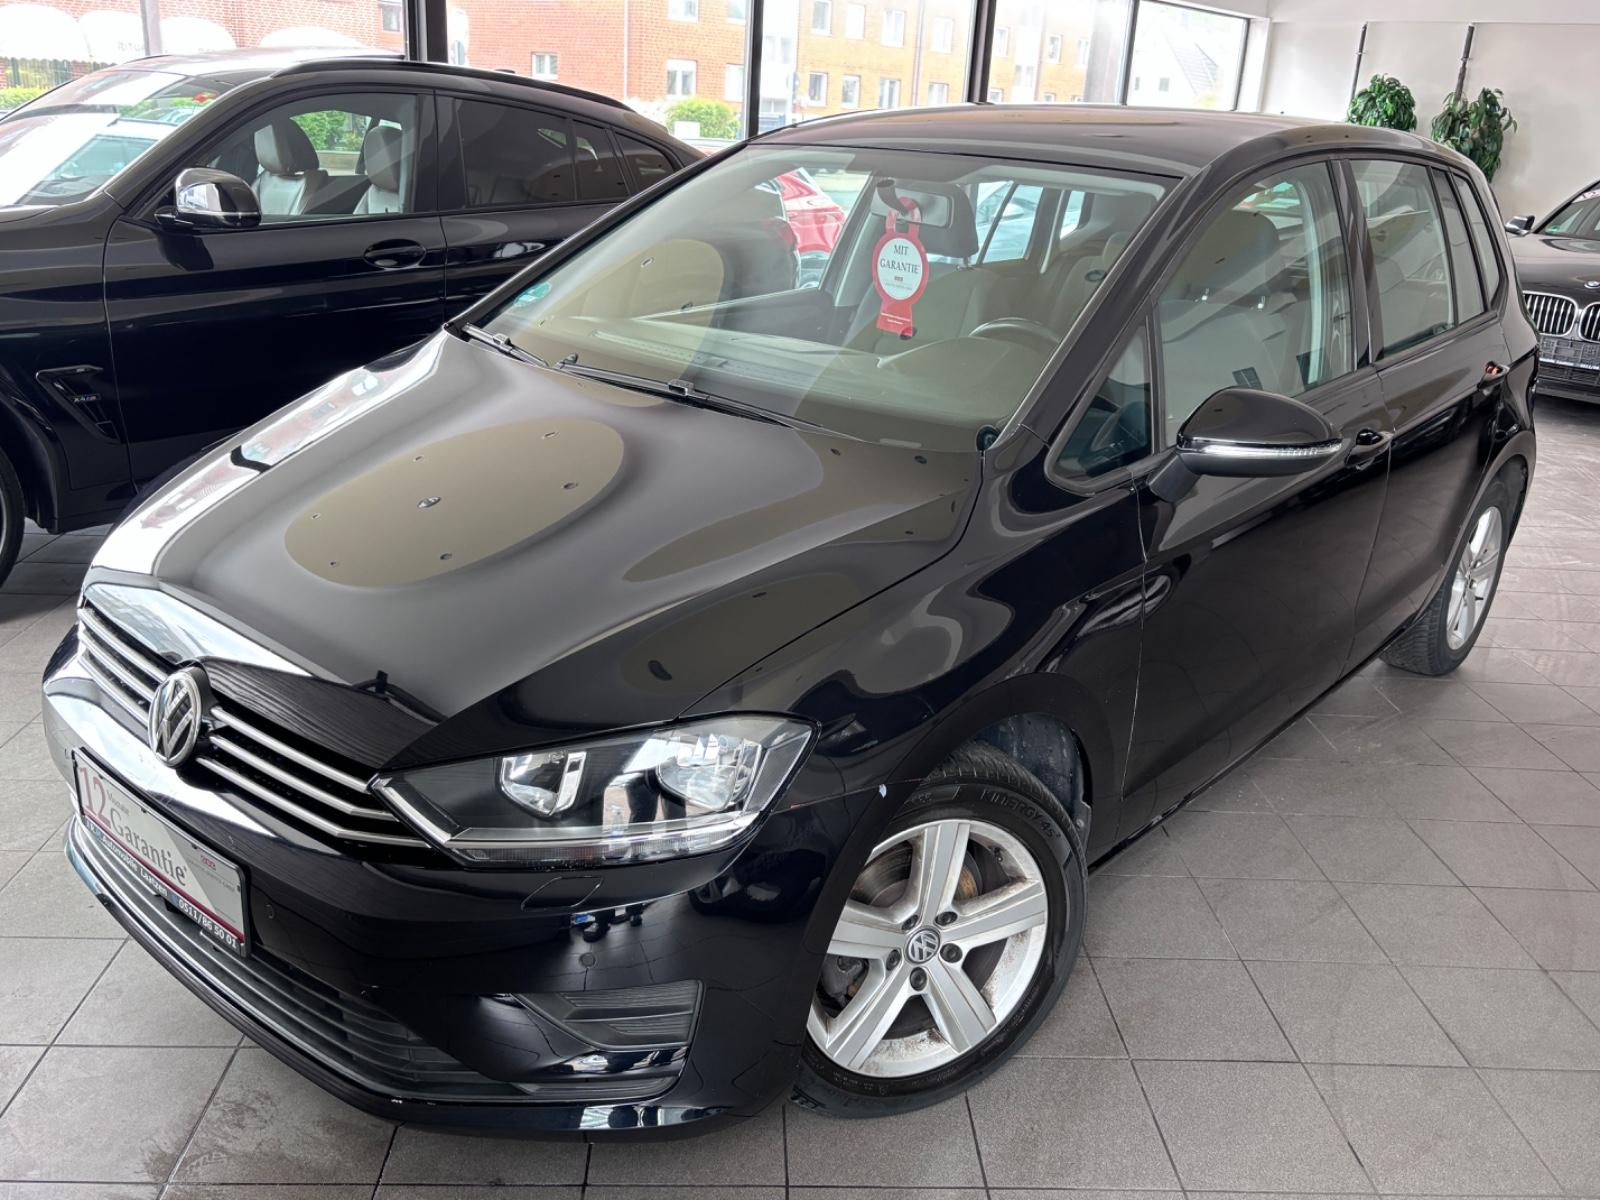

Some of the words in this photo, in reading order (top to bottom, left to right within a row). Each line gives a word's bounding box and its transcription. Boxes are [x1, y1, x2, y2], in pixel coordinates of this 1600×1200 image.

[893, 244, 909, 256] MIT
[880, 258, 920, 274] GARANTIE
[80, 767, 111, 829] 12
[110, 807, 186, 887] Garantie
[226, 937, 237, 950] 01
